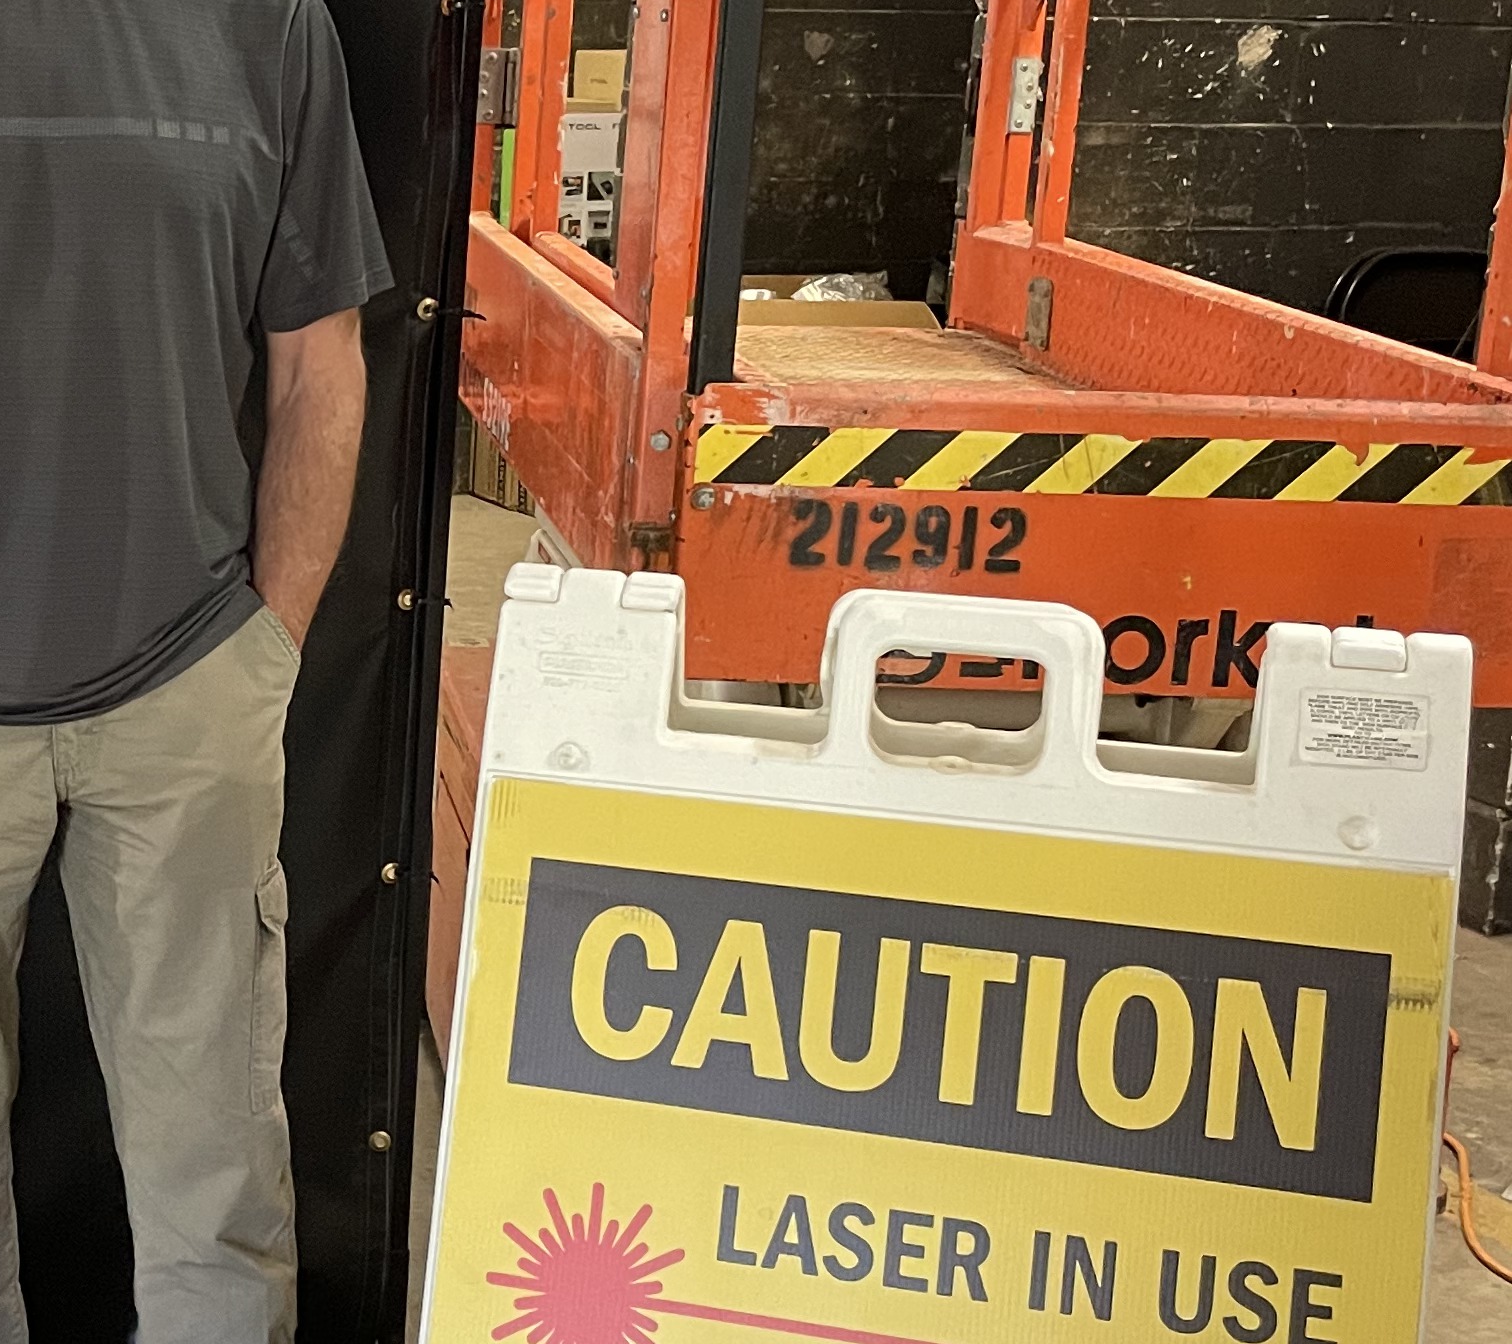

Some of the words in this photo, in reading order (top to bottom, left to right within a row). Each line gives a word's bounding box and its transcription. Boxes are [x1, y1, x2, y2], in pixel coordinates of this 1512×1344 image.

[788, 498, 1028, 574] 212912
[570, 904, 1328, 1152] CAUTION
[716, 1183, 992, 1304] LASER
[1027, 1229, 1118, 1322] IN
